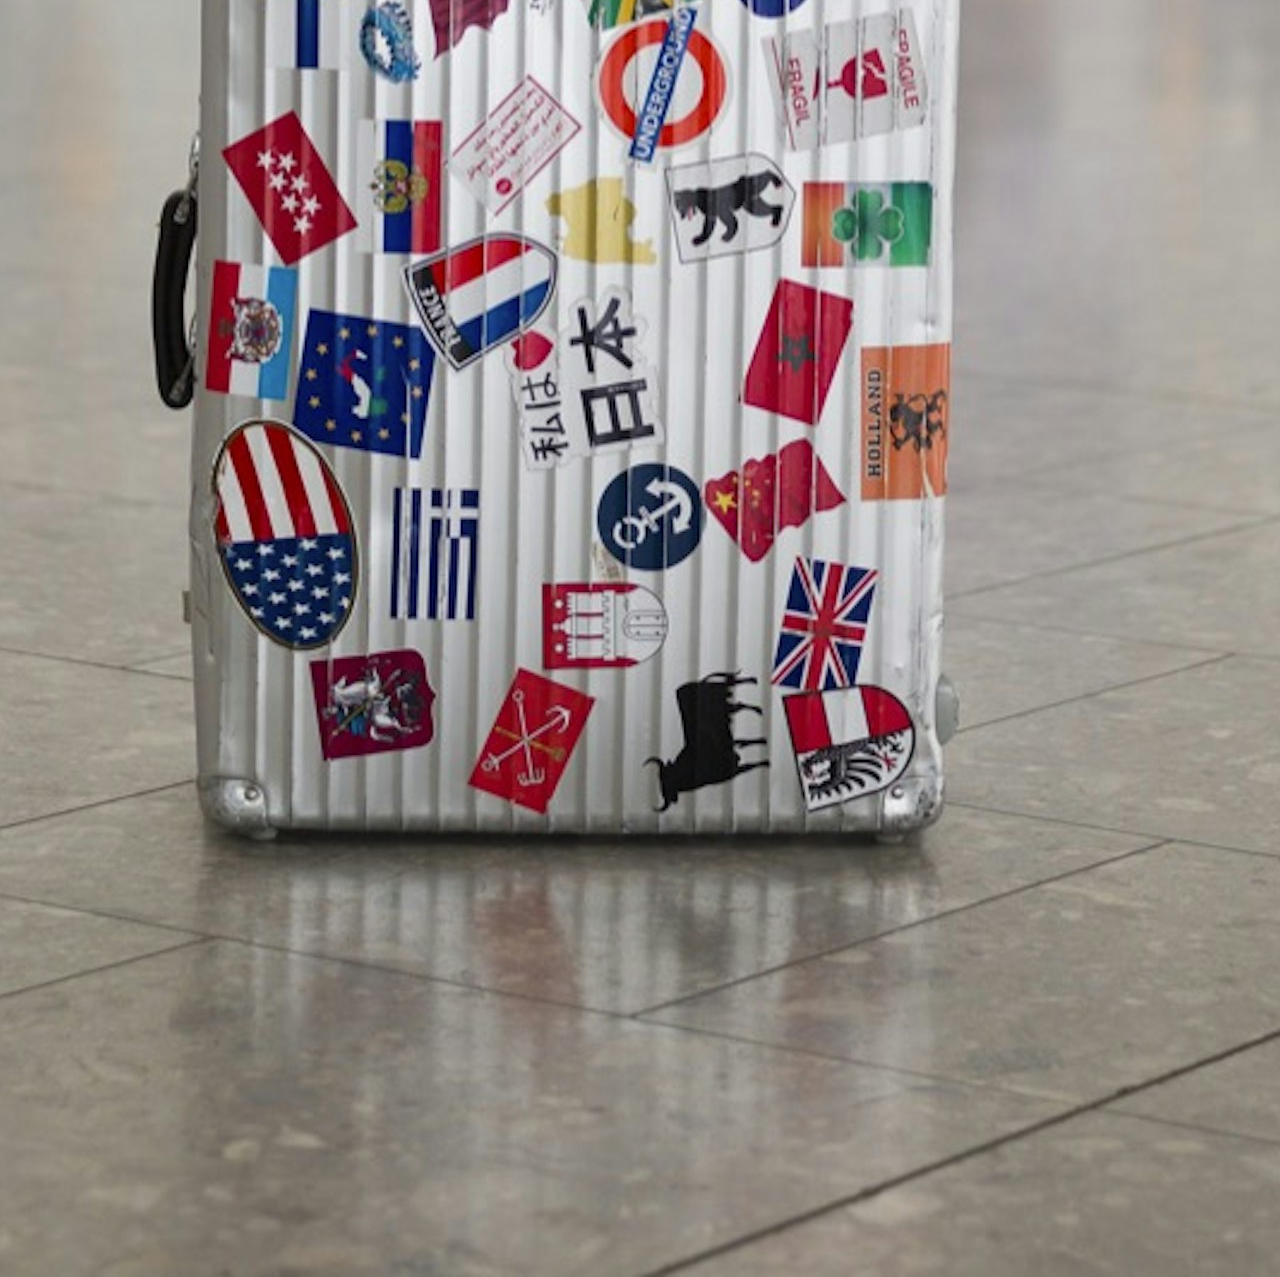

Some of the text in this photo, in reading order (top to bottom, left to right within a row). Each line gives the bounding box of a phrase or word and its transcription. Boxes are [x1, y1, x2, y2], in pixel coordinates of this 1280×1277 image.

[635, 8, 692, 158] UNDERGROUND
[788, 56, 811, 126] FRAGIL
[419, 285, 461, 347] FRANCE
[521, 372, 568, 461] 私は
[570, 297, 655, 448] 日本
[867, 370, 881, 477] HOLLAND
